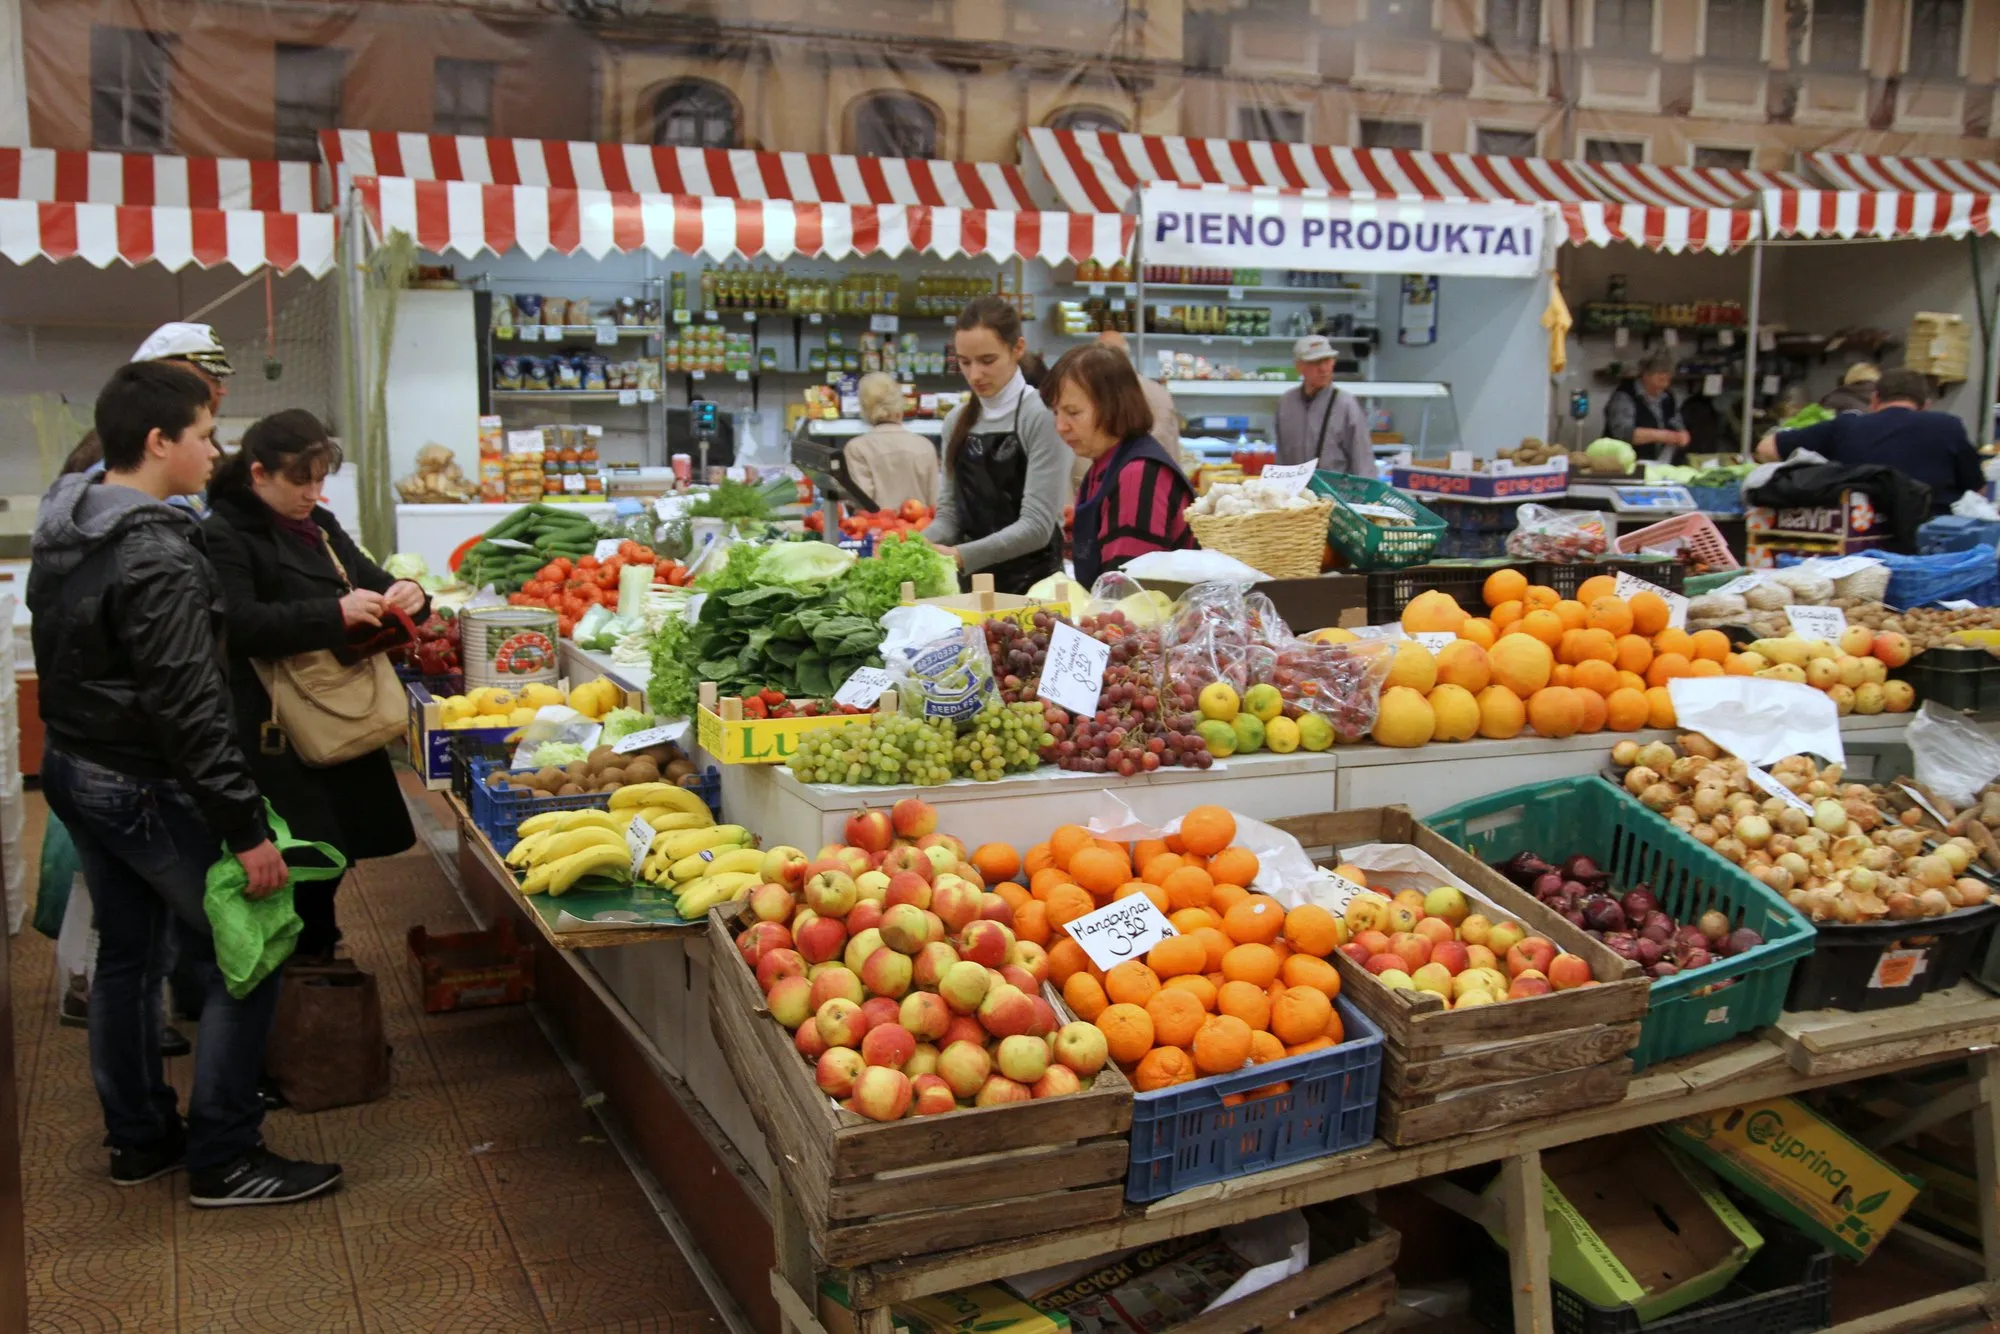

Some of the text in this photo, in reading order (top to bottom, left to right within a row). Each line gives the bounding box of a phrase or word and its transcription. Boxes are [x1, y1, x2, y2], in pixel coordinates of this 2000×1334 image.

[1155, 210, 1534, 257] PIENO PRODUKTAI
[1408, 472, 1472, 494] gregal
[1493, 471, 1567, 497] gregal
[930, 694, 979, 714] SEEDLESS
[1071, 899, 1151, 941] Mandarinai
[1746, 1109, 1848, 1188] Cyprina
